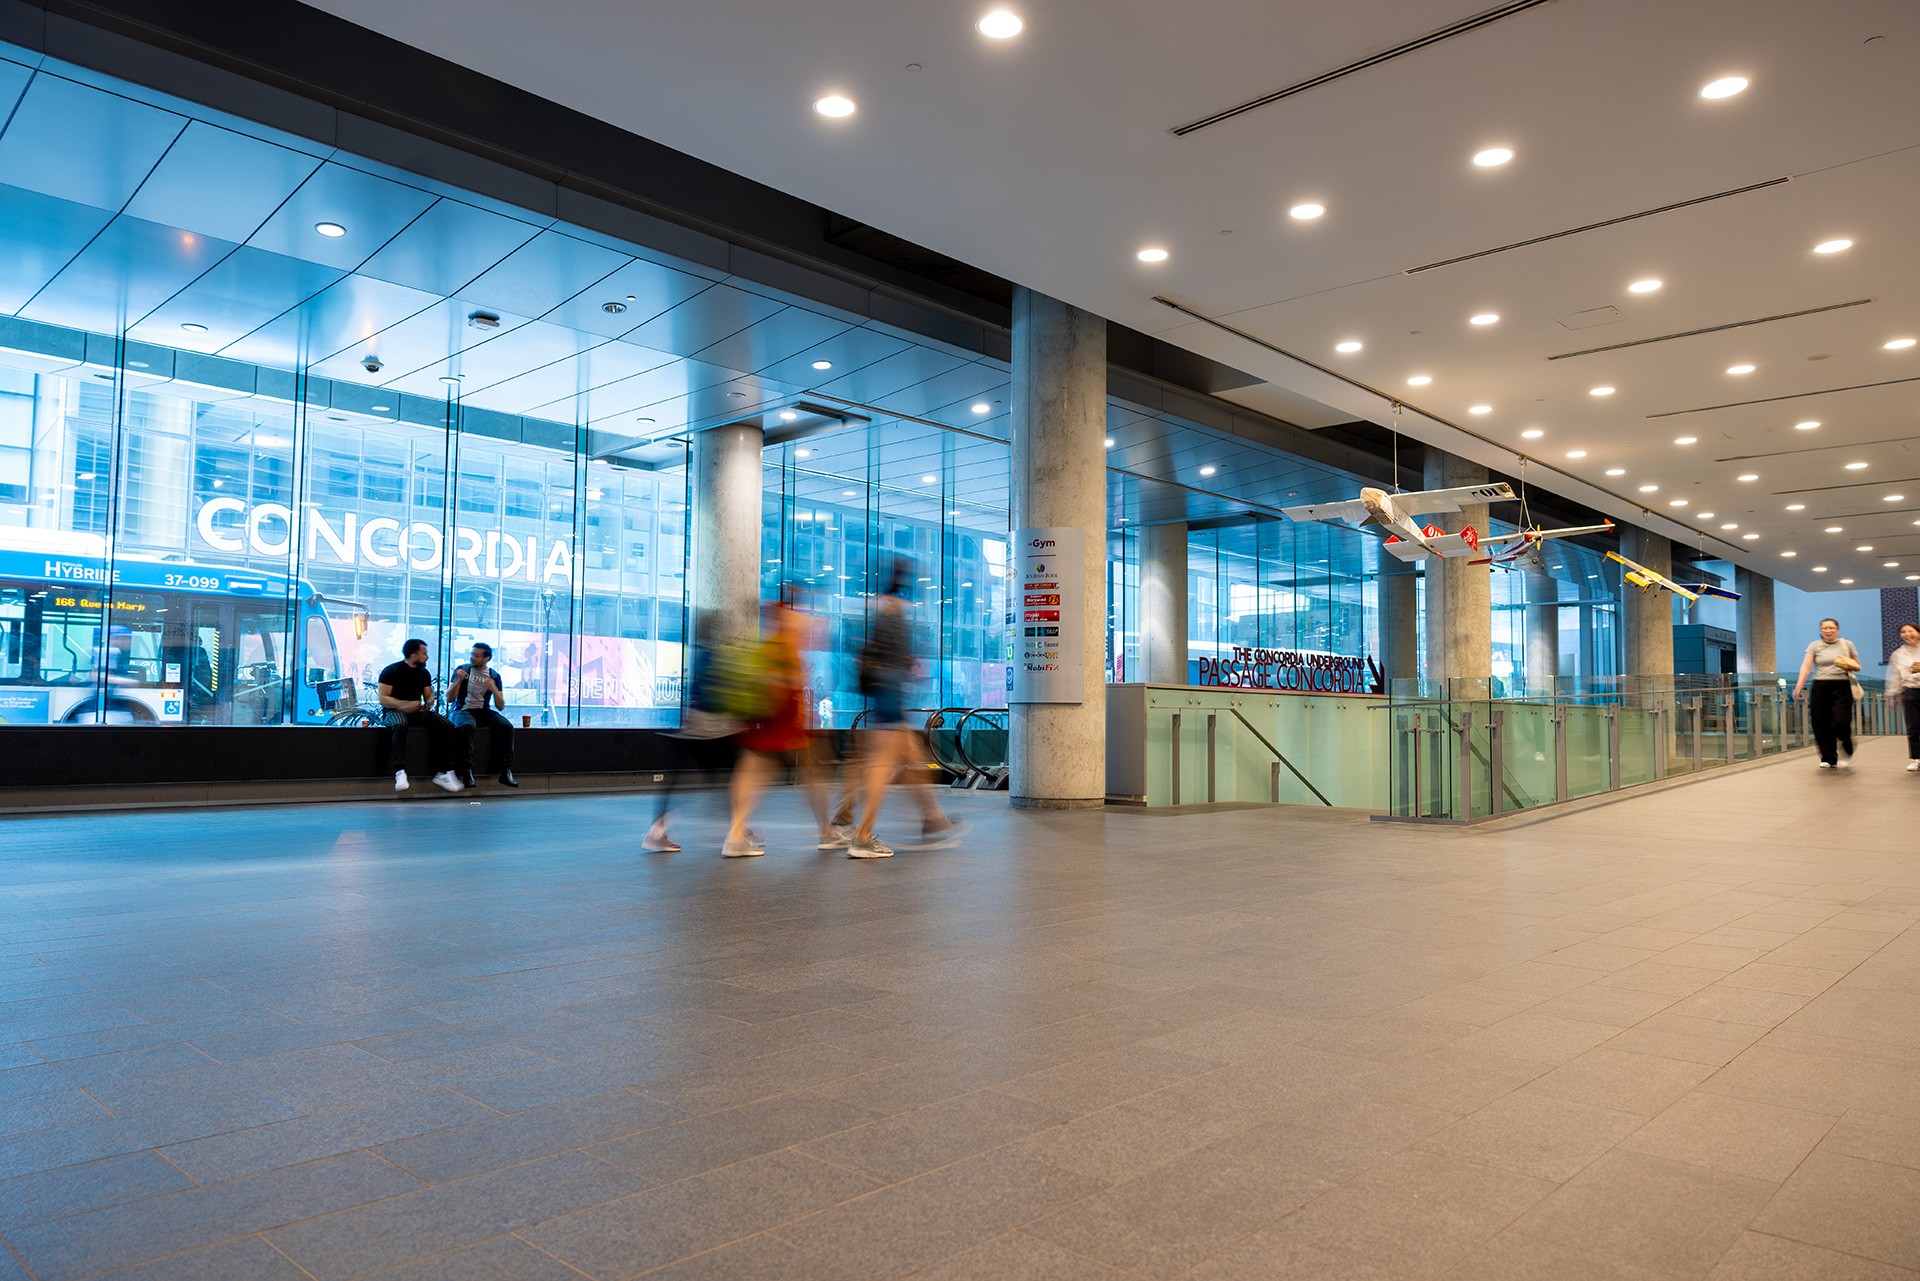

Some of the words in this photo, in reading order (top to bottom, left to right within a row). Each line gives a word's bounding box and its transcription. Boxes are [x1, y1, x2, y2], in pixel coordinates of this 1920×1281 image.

[197, 497, 573, 585] CONCORDIA
[1033, 539, 1056, 549] Gym
[165, 573, 219, 589] 37-099
[55, 597, 75, 607] 166
[117, 601, 146, 611] Mary
[1233, 646, 1252, 662] THE
[1254, 648, 1305, 666] CONCORDIA
[1306, 653, 1365, 670] UNDERGROUND
[1198, 656, 1274, 689] PASSAGE
[1276, 663, 1365, 694] CONCORDIA
